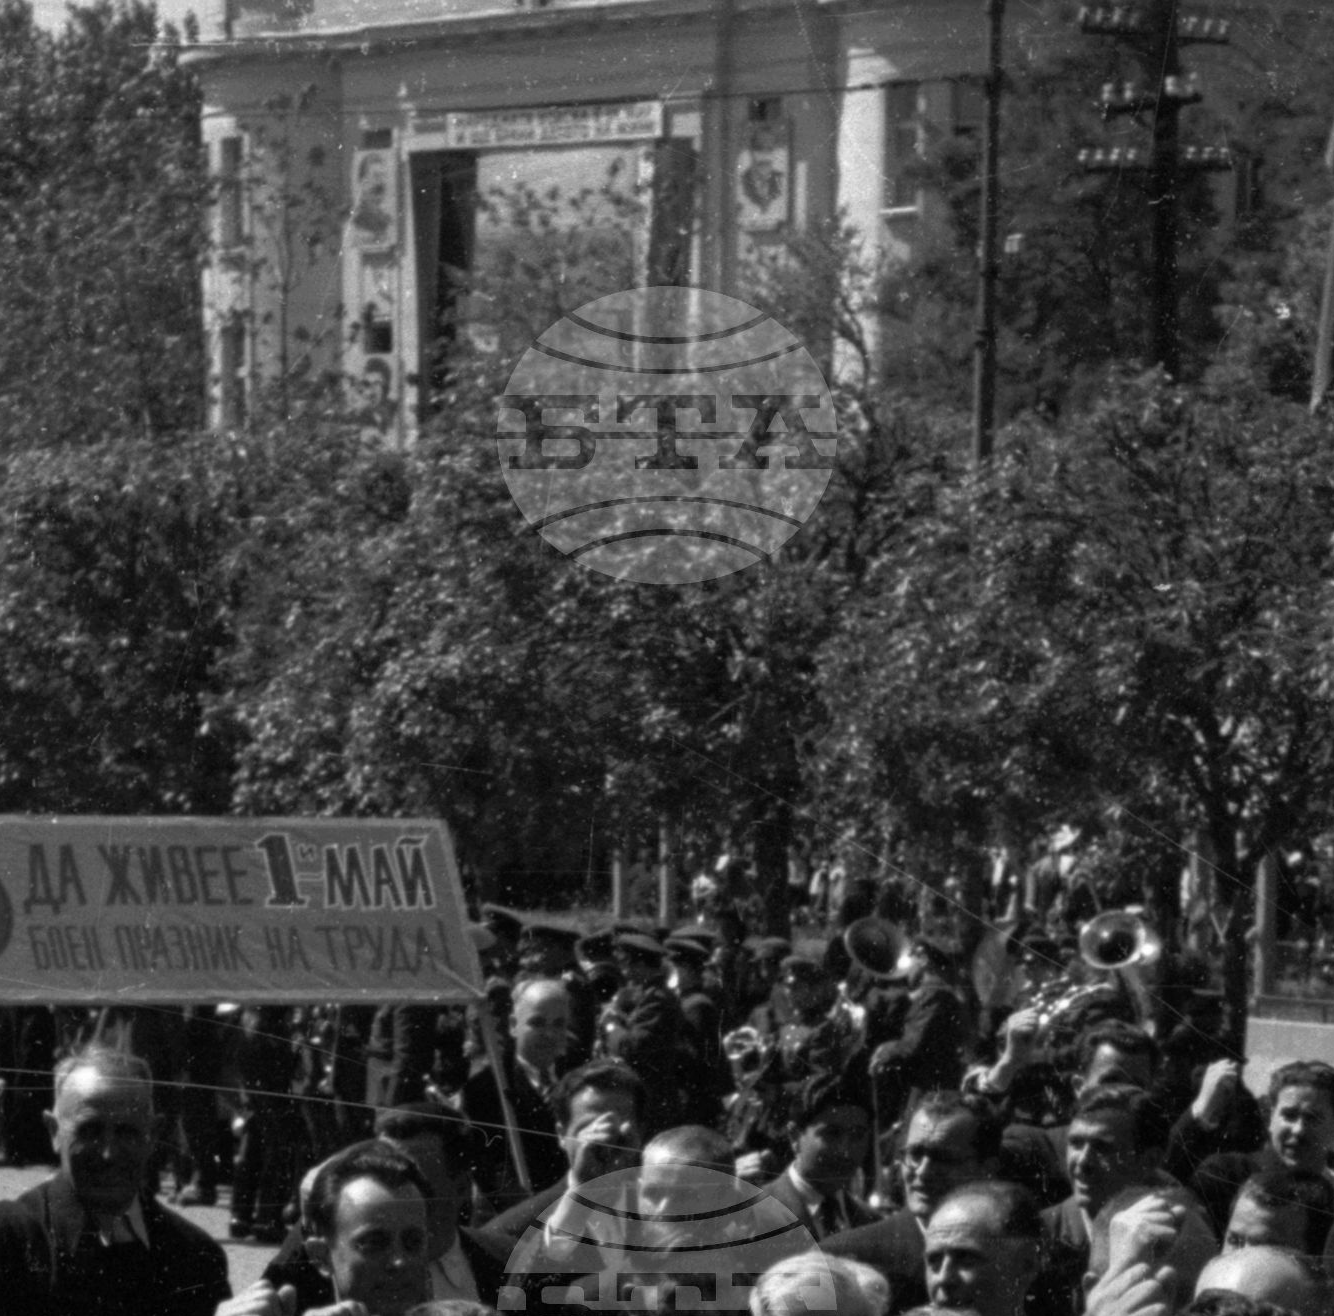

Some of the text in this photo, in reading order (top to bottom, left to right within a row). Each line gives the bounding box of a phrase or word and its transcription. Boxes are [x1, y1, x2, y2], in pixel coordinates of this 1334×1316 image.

[24, 843, 87, 914] ДА
[96, 843, 254, 906] ЖИВЕЕ
[113, 924, 255, 971] ПРАЗНИК
[263, 925, 313, 972] НА
